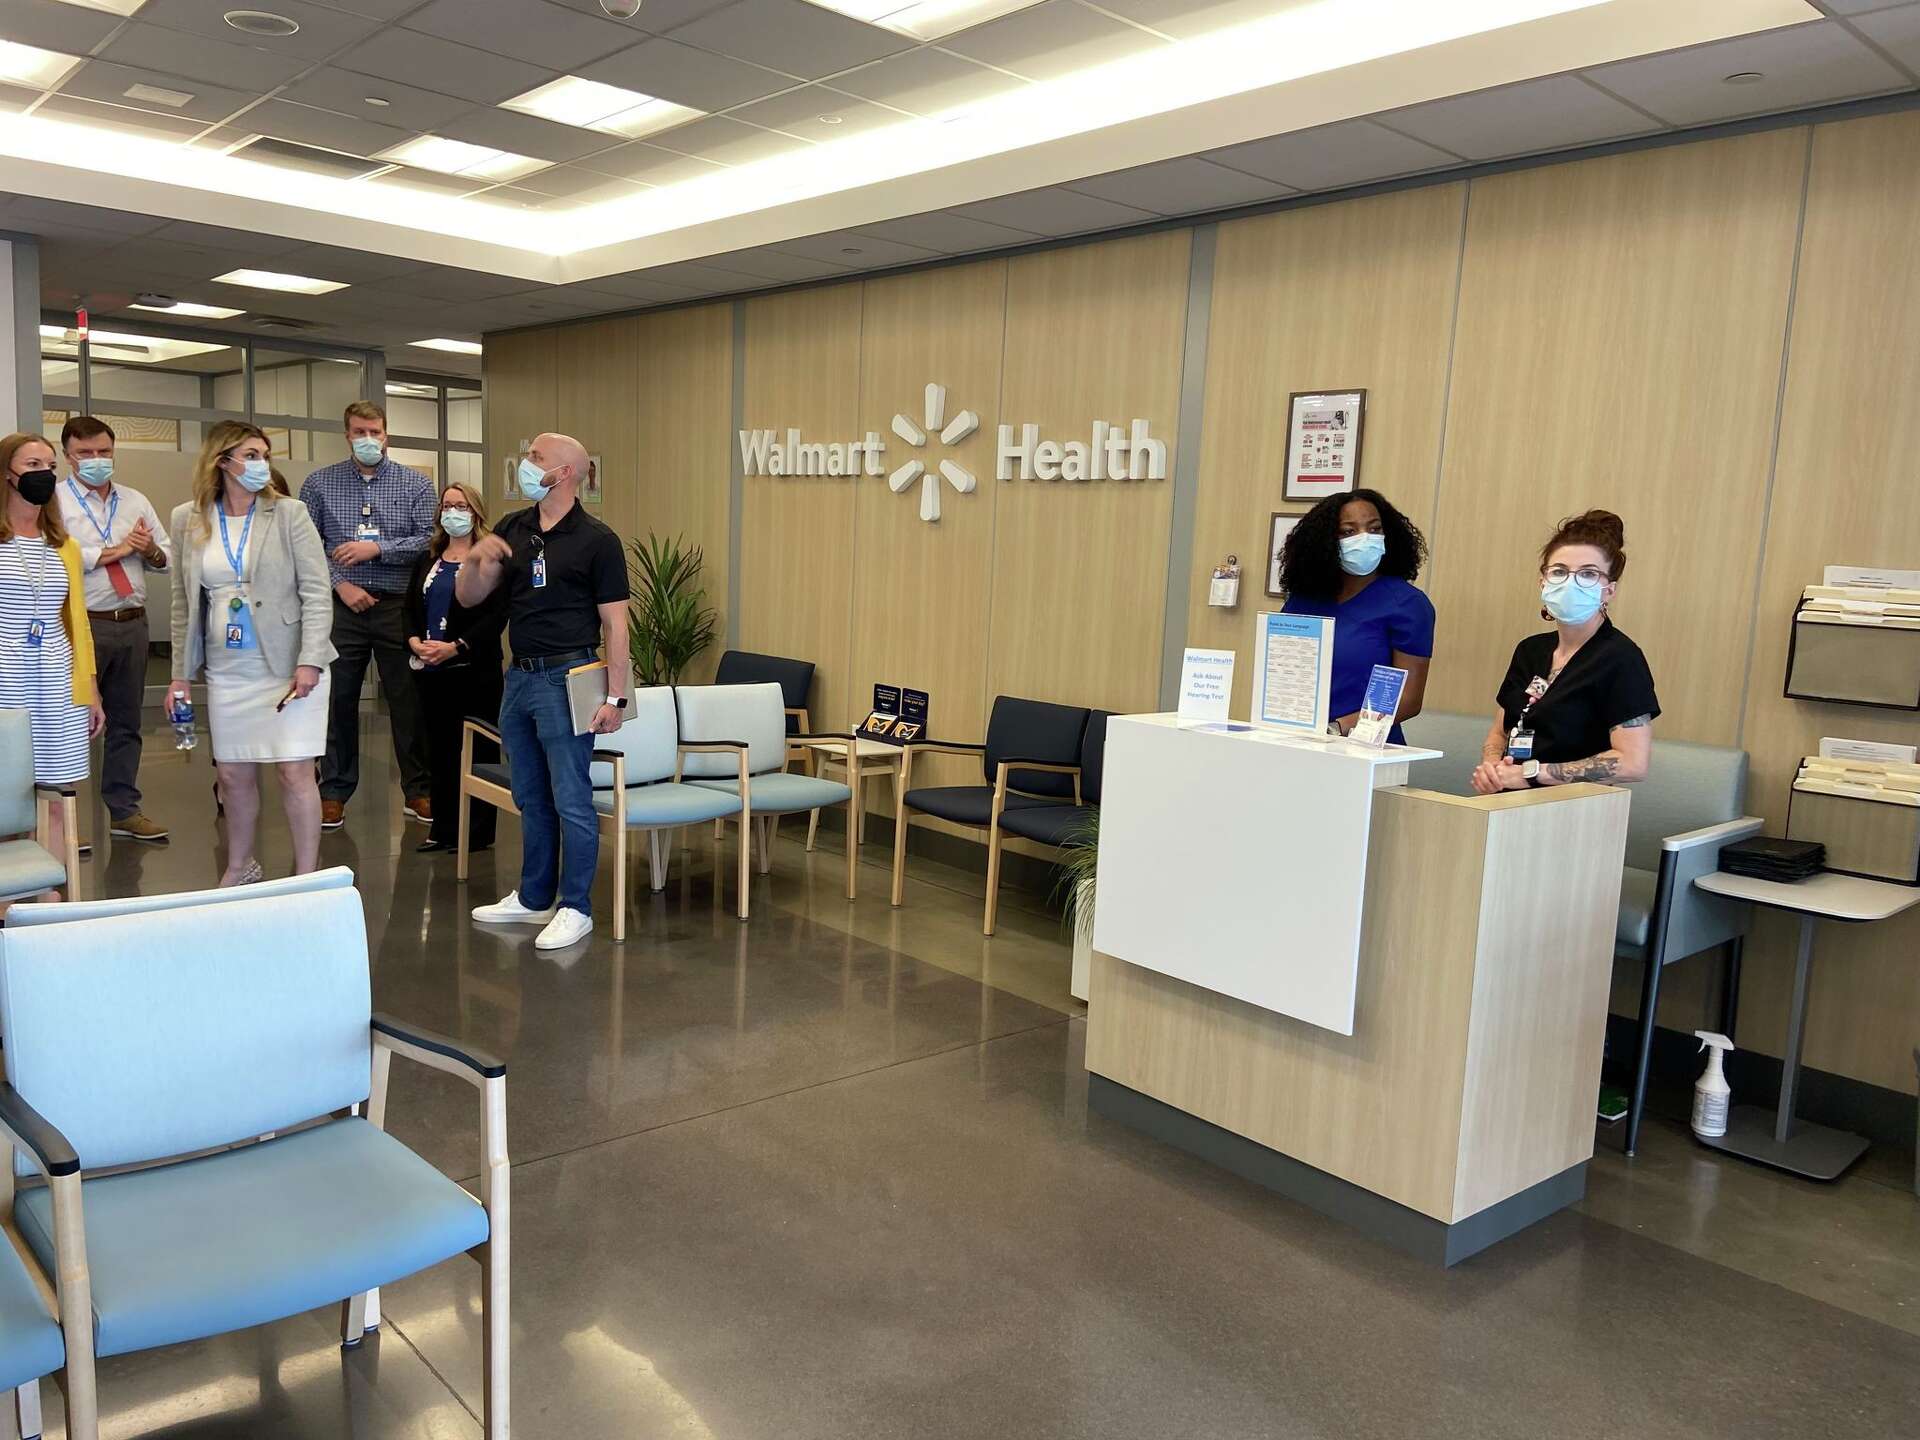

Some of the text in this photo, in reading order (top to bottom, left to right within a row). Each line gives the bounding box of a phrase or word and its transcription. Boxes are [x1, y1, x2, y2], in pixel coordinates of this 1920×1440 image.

[739, 418, 1167, 481] Walmart Health
[1213, 656, 1233, 664] Health
[1187, 691, 1210, 700] Hearing
